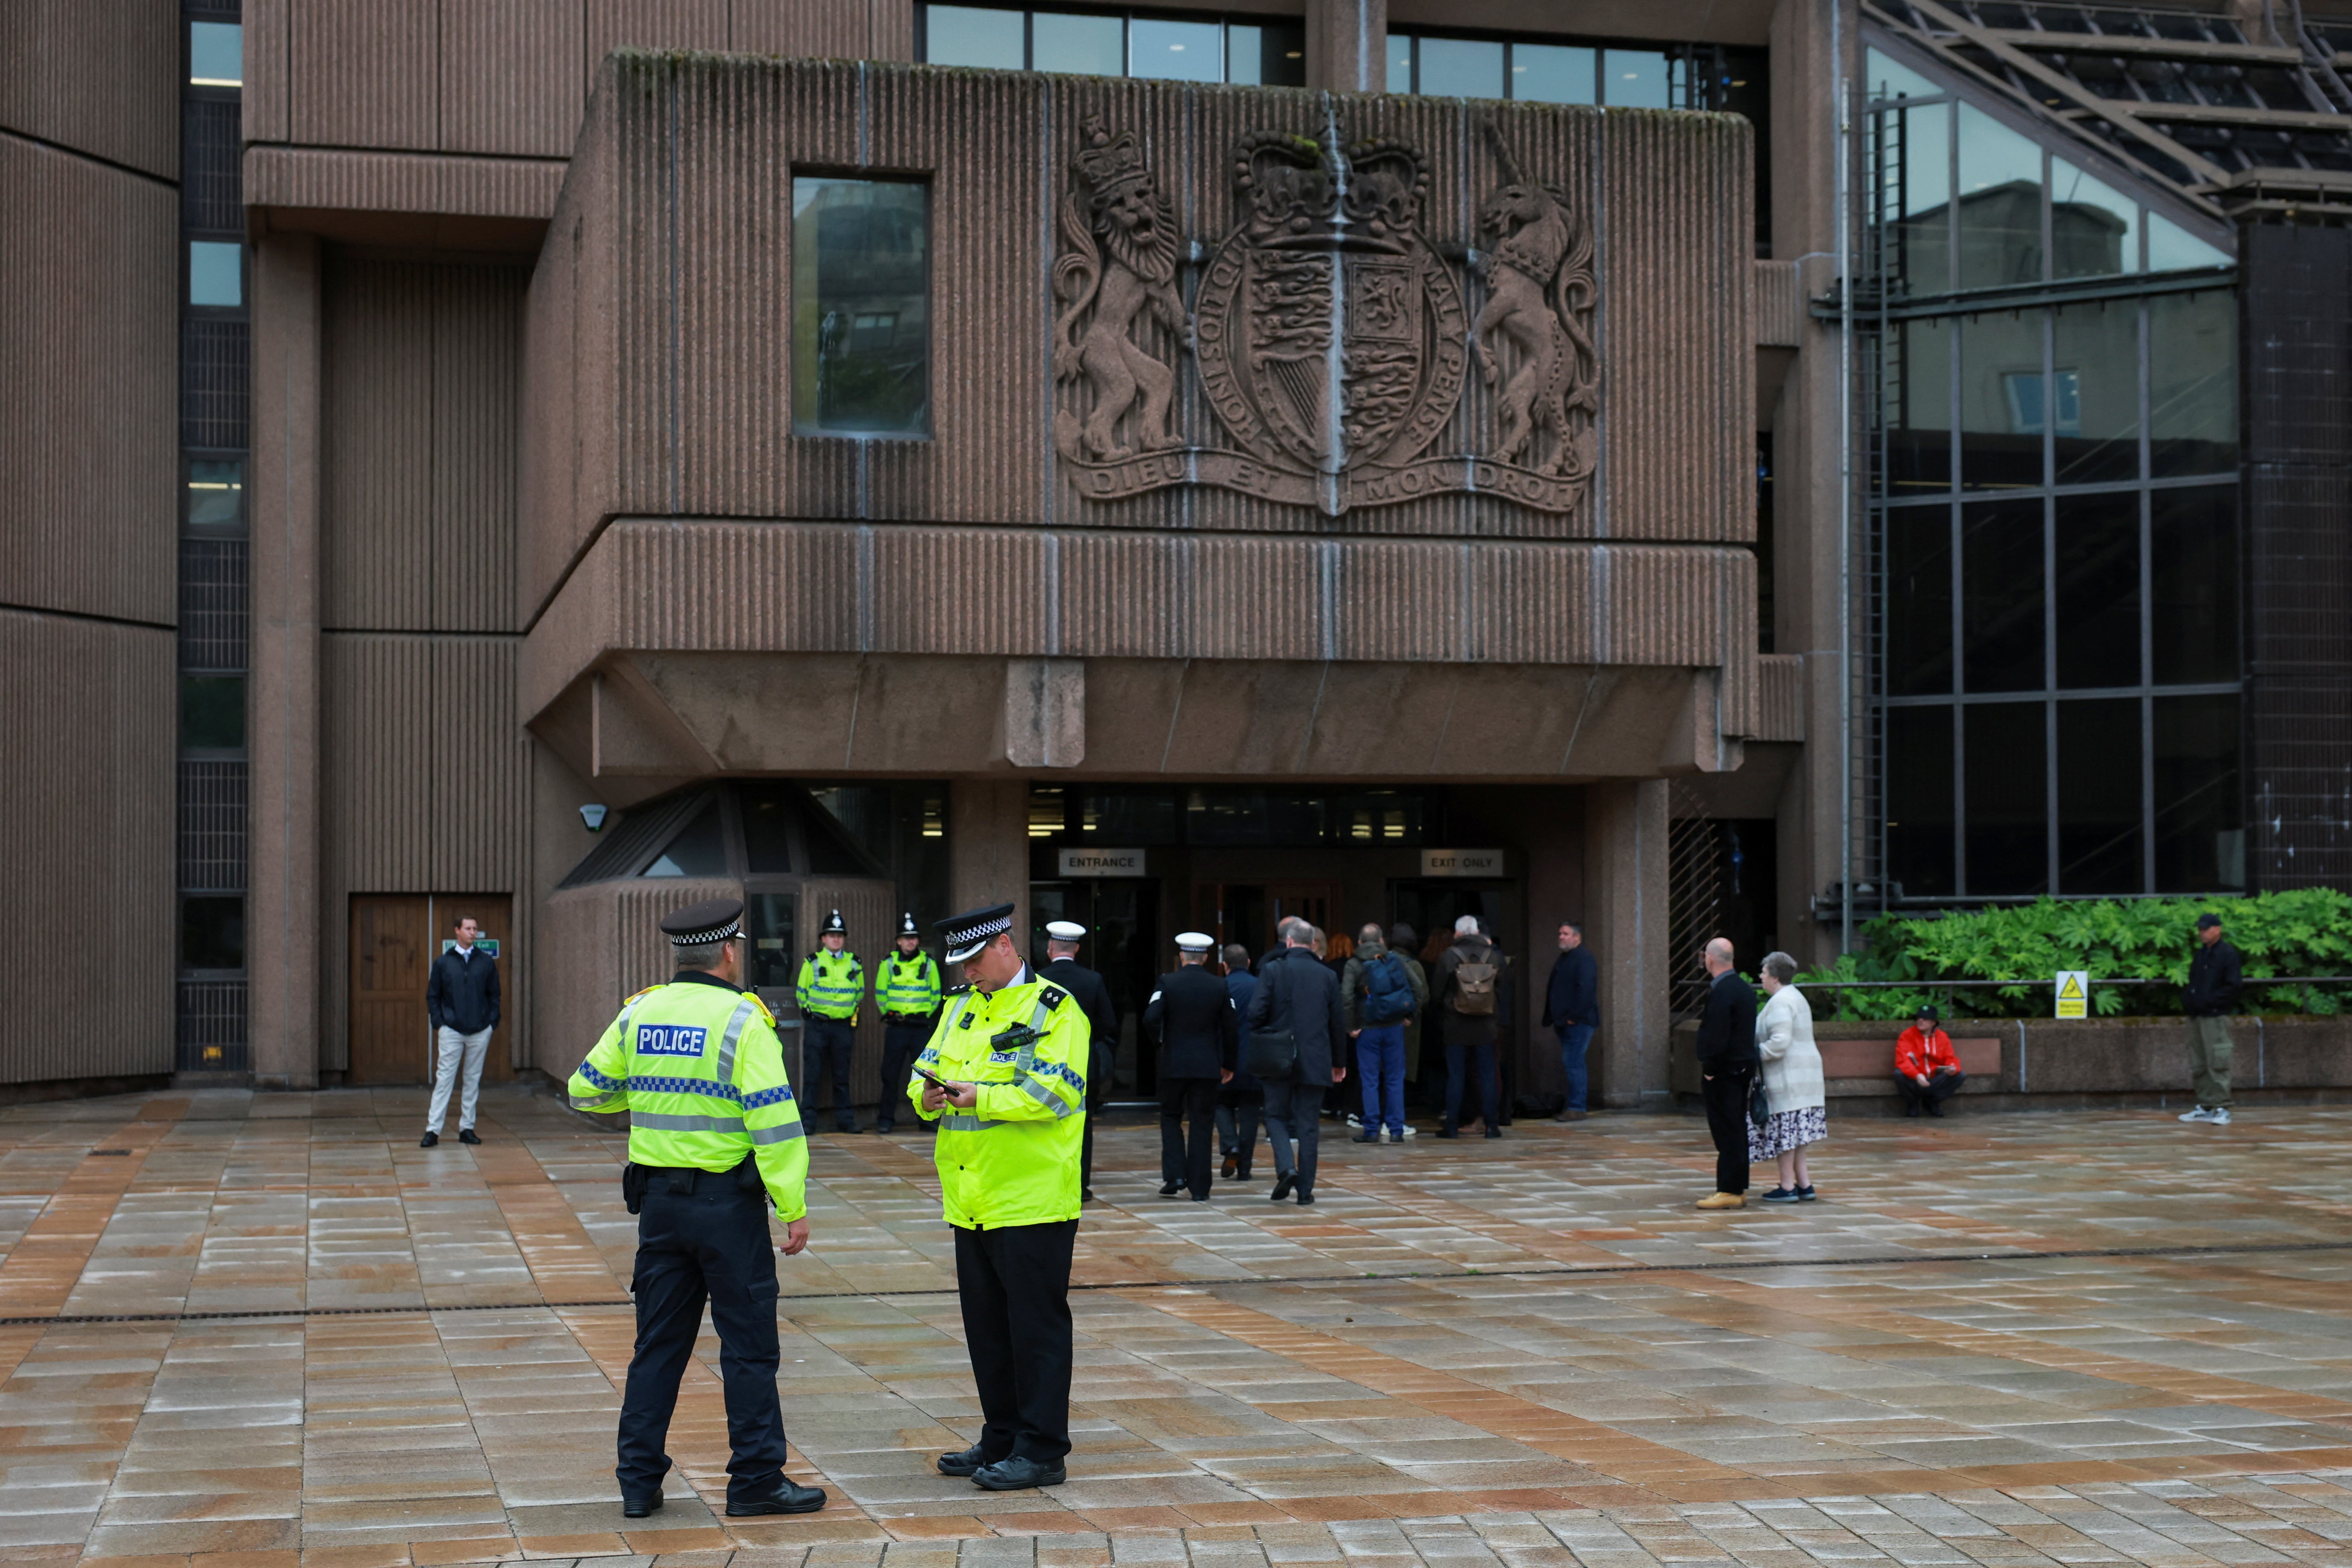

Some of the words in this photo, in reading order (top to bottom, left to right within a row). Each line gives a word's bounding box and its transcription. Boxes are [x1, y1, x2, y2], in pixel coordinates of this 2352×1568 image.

[1422, 251, 1461, 322] MAL
[1200, 293, 1225, 361] SOIT
[1405, 355, 1460, 446] PENSE
[1092, 453, 1185, 494] DIEU
[1230, 462, 1279, 493] ET
[1366, 462, 1452, 500] MON
[1474, 466, 1580, 508] DROIT
[1069, 858, 1135, 867] ENTRANCE
[1431, 858, 1455, 867] EXIT
[1463, 858, 1492, 867] ONLY
[639, 1028, 703, 1052] POLICE
